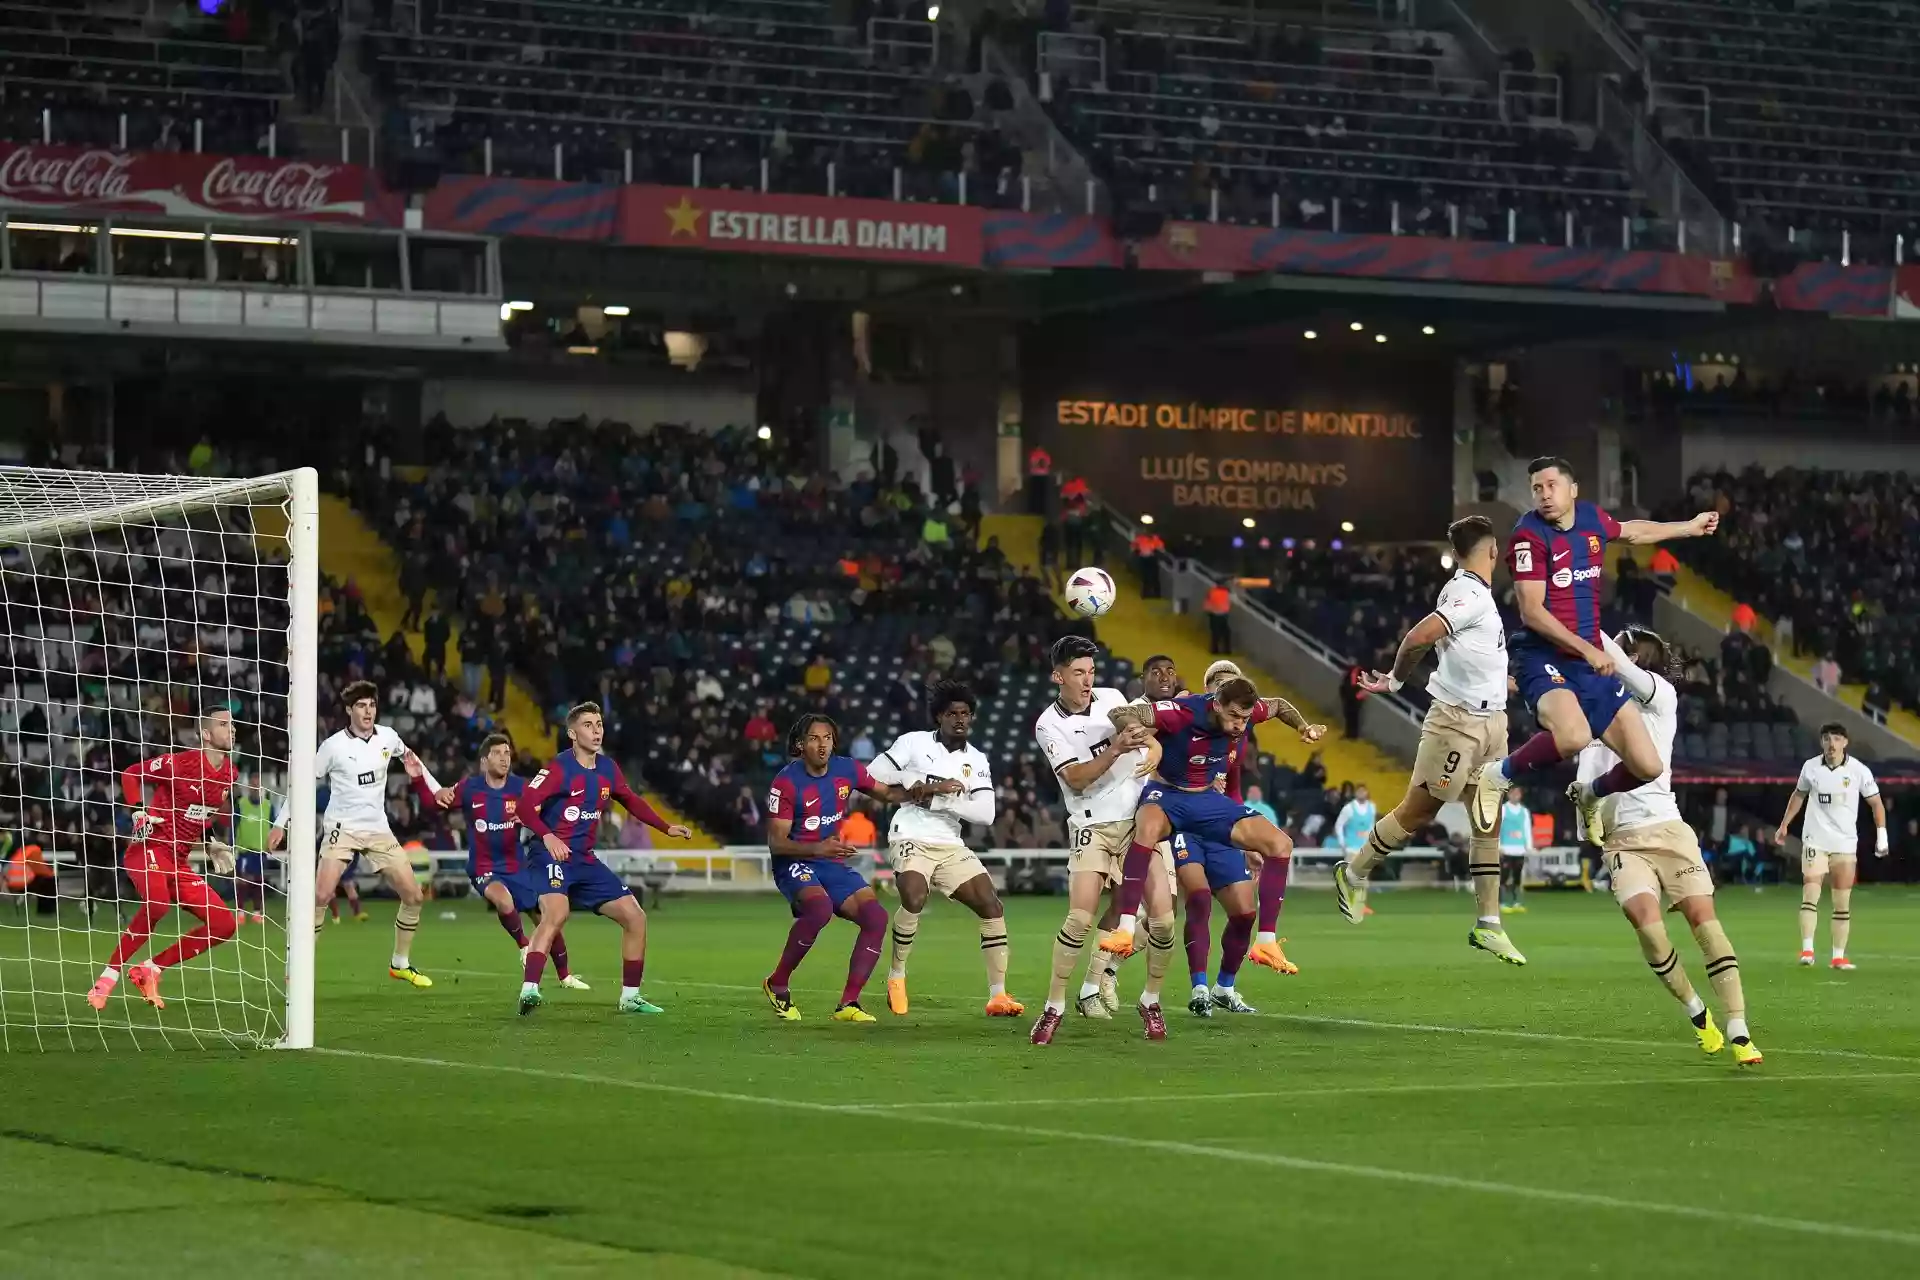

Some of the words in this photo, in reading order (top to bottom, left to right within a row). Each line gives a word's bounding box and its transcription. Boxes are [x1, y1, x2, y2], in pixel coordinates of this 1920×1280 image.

[709, 210, 850, 246] ESTRELLA
[856, 218, 947, 252] DAMM
[1058, 401, 1147, 428] ESTADI
[1156, 402, 1258, 433] OLÍMPIC
[1265, 410, 1296, 434] DE
[1141, 453, 1209, 481] LLUÍS
[1218, 458, 1348, 487] COMPANYS
[1173, 483, 1315, 510] BARCELONA
[1444, 751, 1460, 773] 9
[329, 829, 340, 845] 8
[1075, 829, 1092, 848] 18
[1174, 834, 1186, 848] 4
